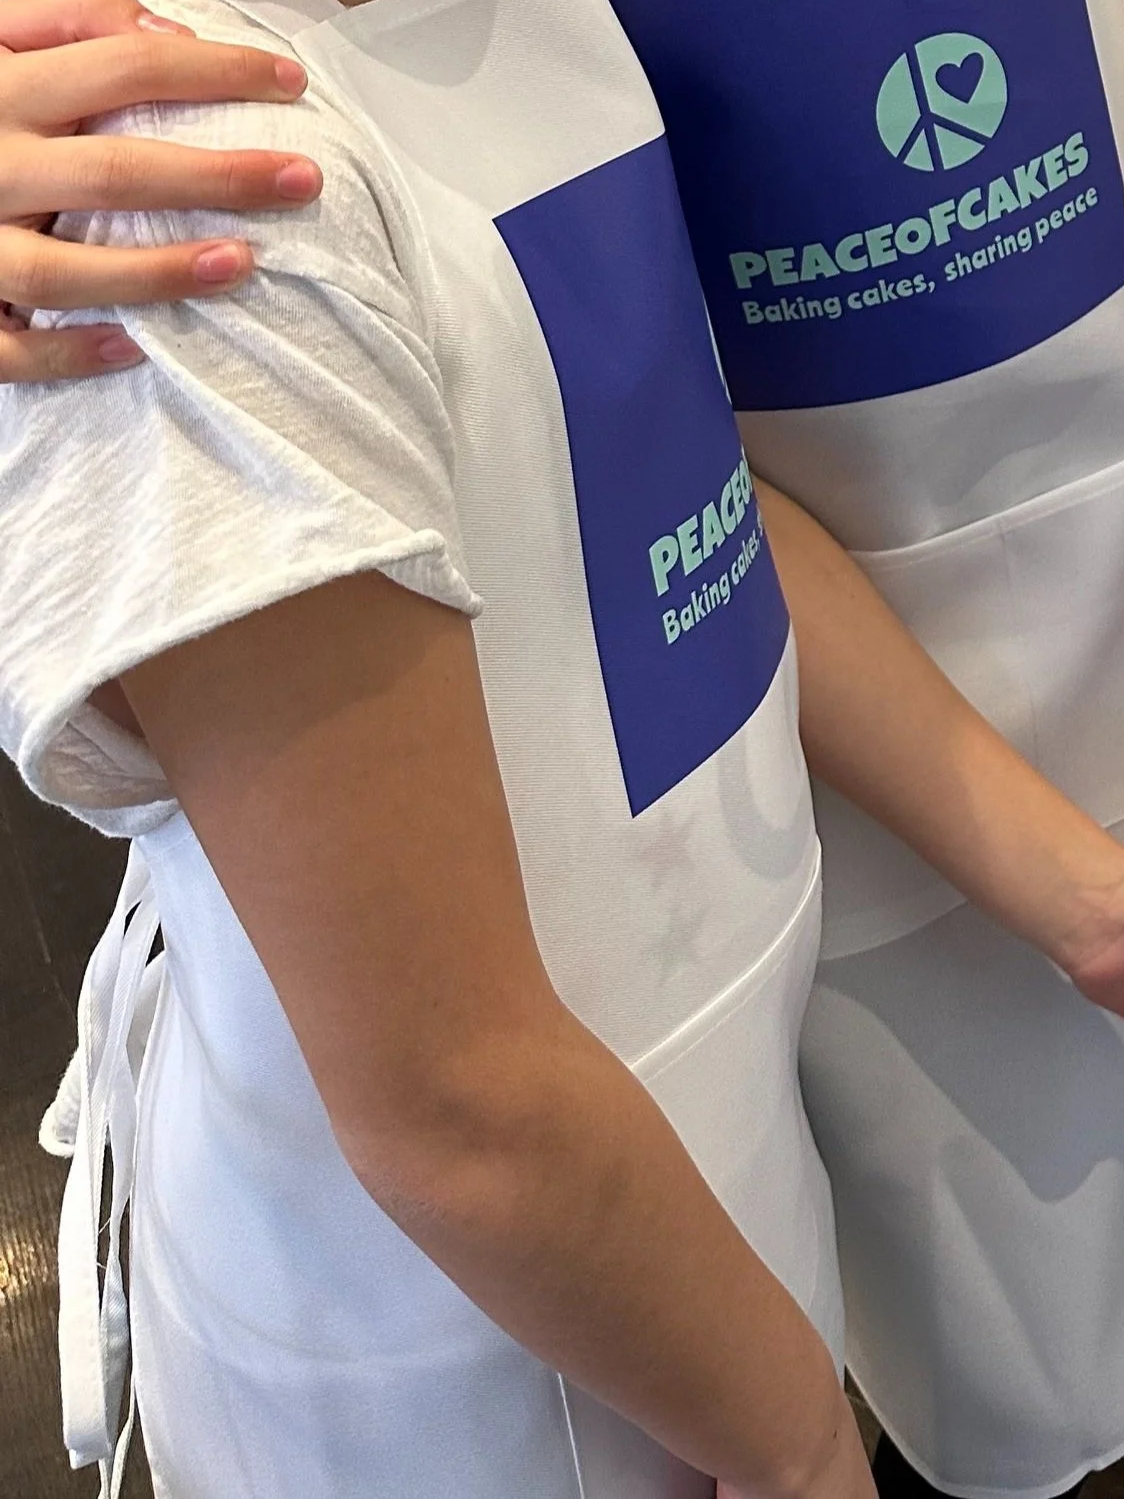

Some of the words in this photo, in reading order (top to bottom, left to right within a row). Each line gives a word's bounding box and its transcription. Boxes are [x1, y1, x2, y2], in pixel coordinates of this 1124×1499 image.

[729, 132, 1090, 289] PEACEOFCAKES
[742, 296, 842, 325] Baking
[847, 271, 936, 310] cakes,
[944, 226, 1033, 282] sharing
[1036, 186, 1098, 244] peace
[648, 458, 752, 597] PEACEO
[662, 571, 731, 646] Baking
